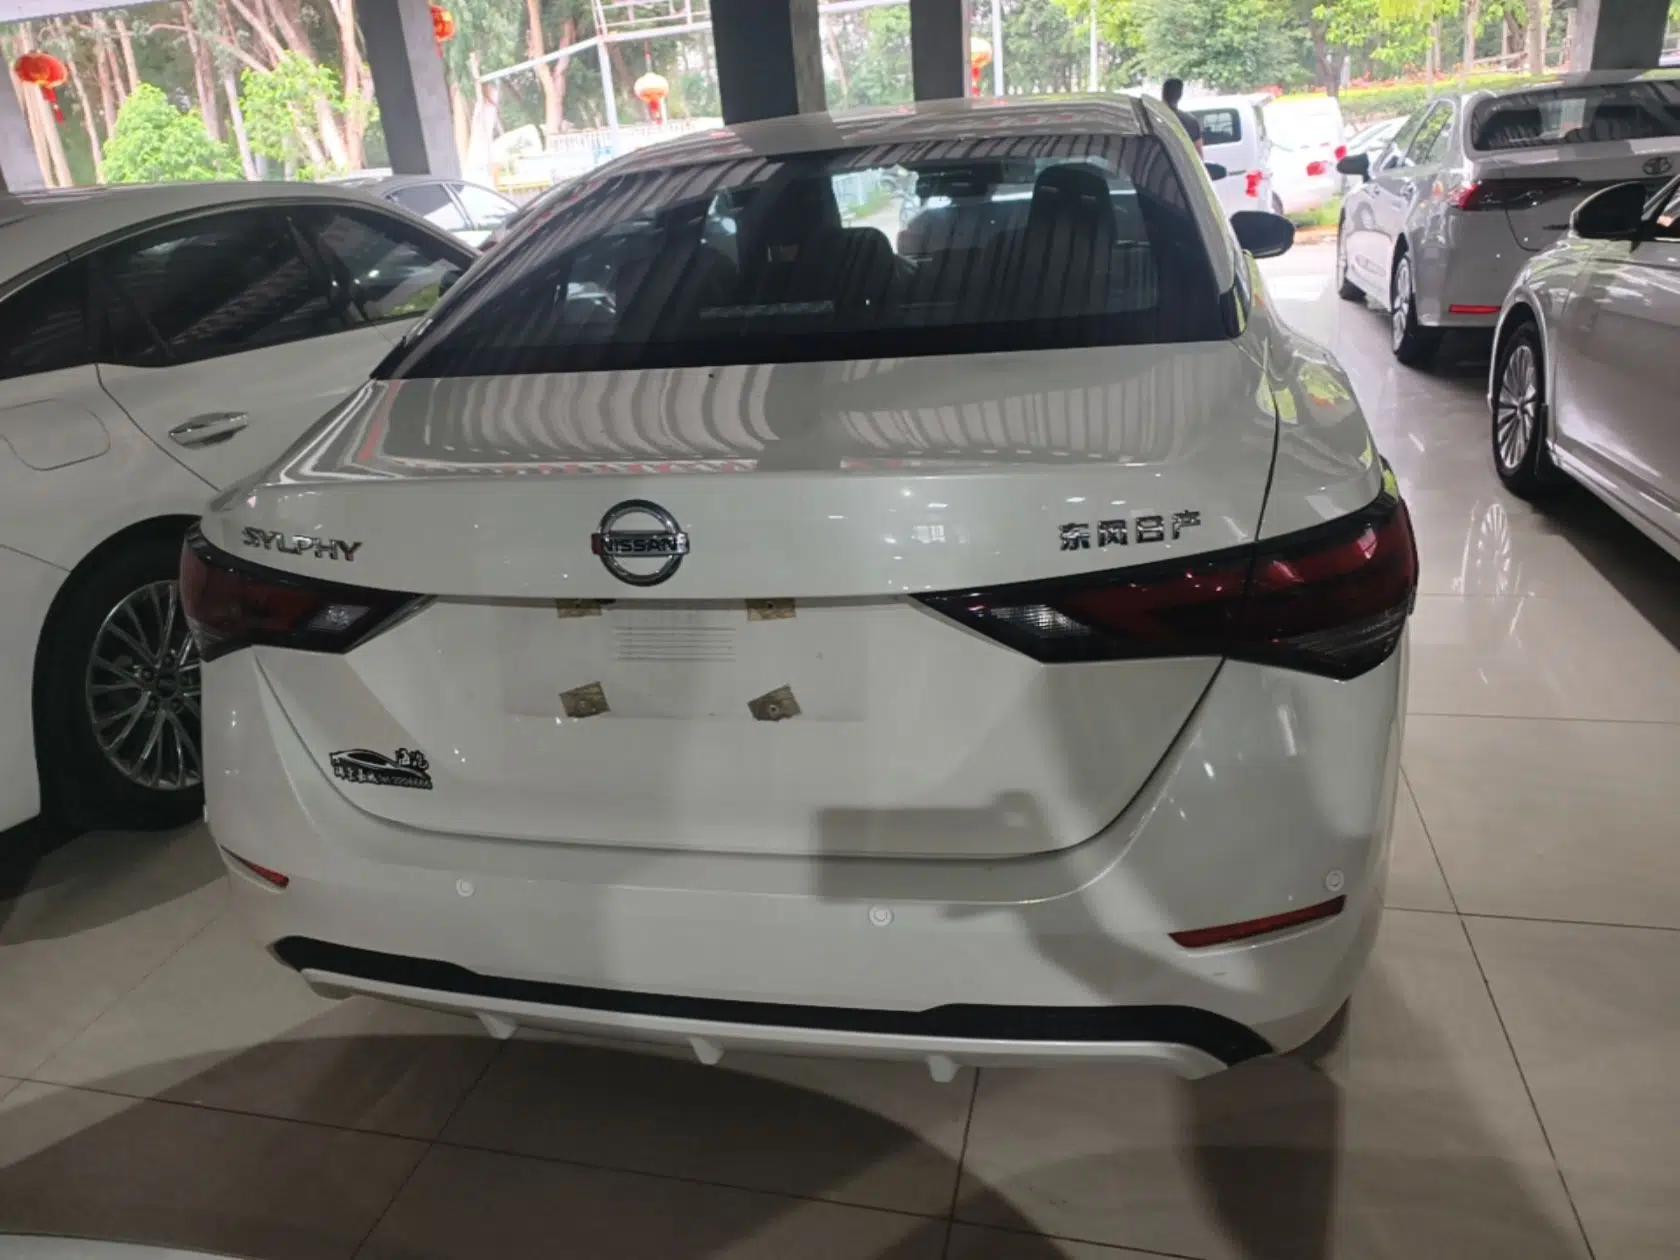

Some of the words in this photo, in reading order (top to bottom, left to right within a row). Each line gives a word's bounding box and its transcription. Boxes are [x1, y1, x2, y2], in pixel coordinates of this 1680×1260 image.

[242, 526, 362, 562] SYLPHY
[602, 536, 679, 553] NISSAN
[1059, 510, 1201, 551] 东风日产
